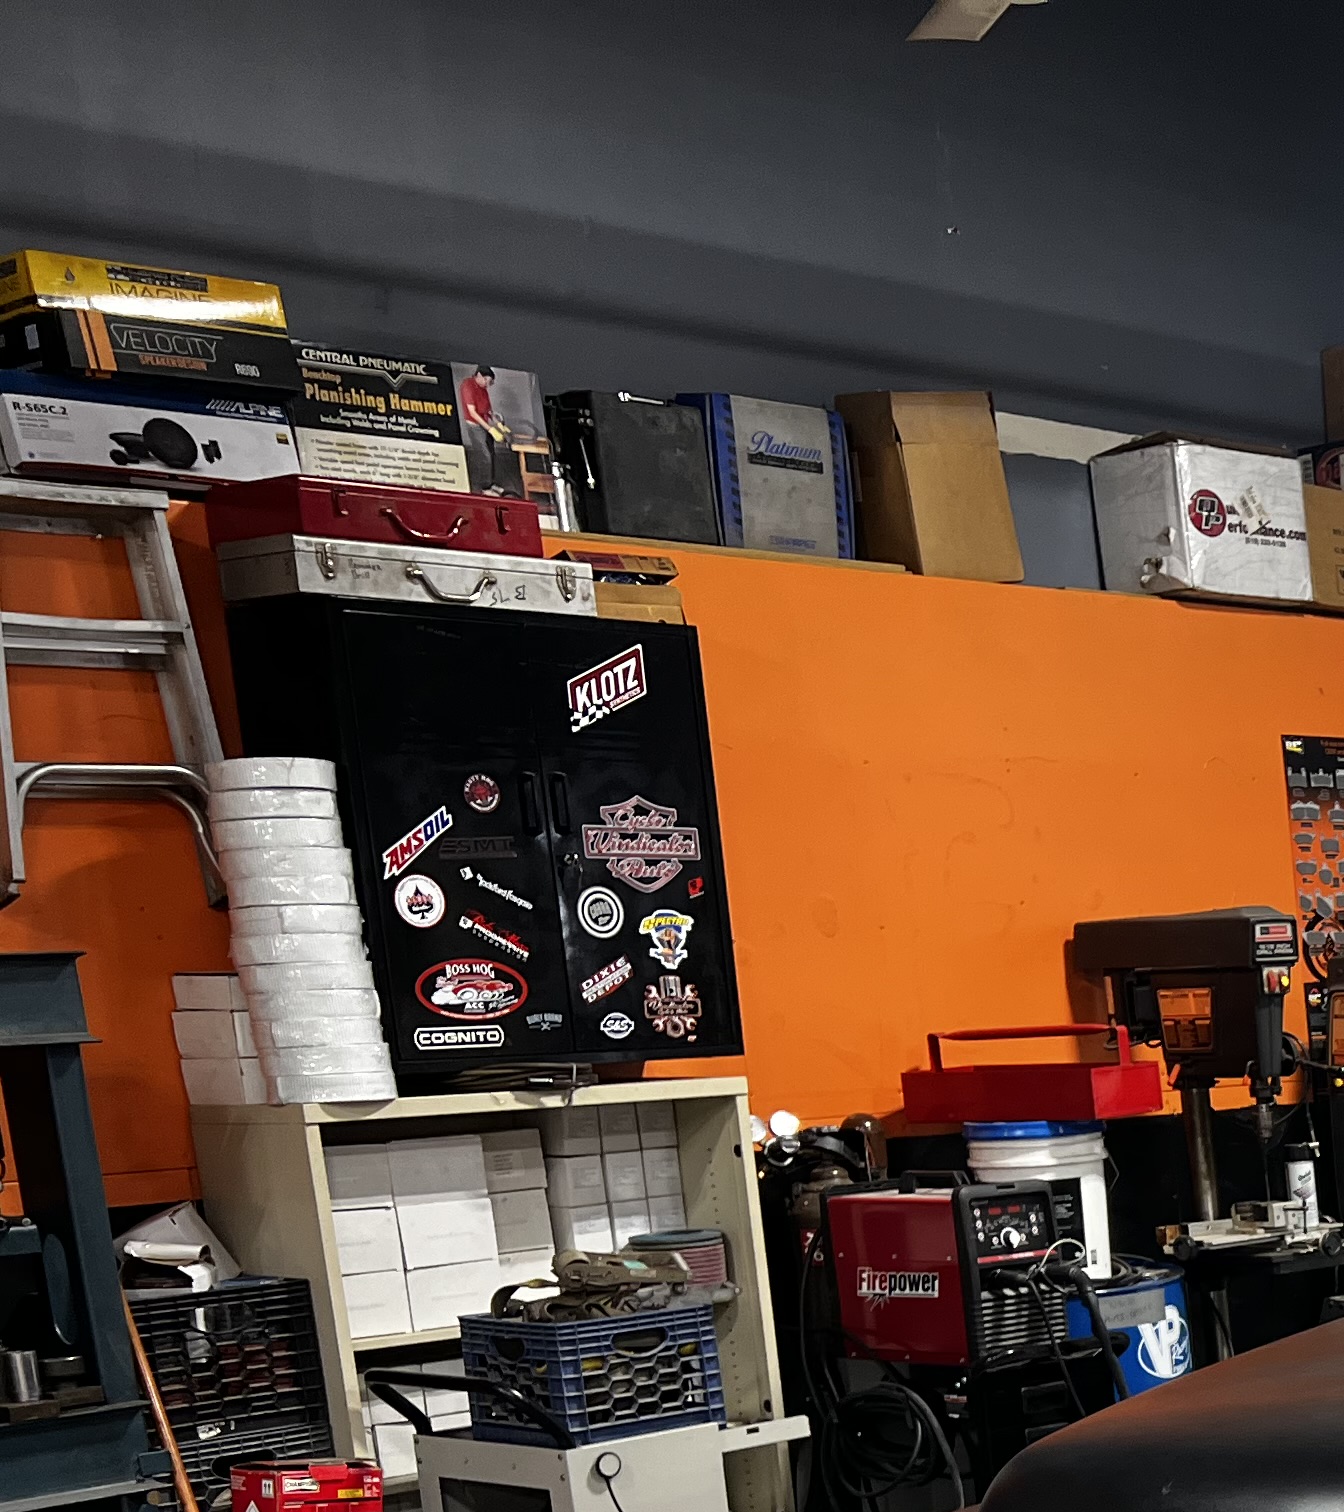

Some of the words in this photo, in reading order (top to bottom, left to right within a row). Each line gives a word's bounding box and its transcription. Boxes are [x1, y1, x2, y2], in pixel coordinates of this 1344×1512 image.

[114, 329, 217, 361] VELOCITY
[301, 348, 357, 367] CENTRAL
[359, 355, 428, 375] PNEUMATIC
[230, 401, 284, 418] ALPINE
[304, 383, 386, 413] Planishing
[389, 392, 453, 417] Hammer
[751, 430, 822, 460] Platinum
[575, 656, 639, 712] KLOTZ
[385, 810, 450, 873] AMSOIL
[586, 830, 695, 854] Vindicator
[445, 964, 471, 979] BOSS
[472, 963, 495, 979] HOG
[582, 955, 628, 990] DIXIE
[588, 972, 631, 1004] DEPOT
[418, 1030, 500, 1045] COGNITO
[605, 1019, 629, 1030] S&S
[858, 1268, 938, 1296] Firepower
[1138, 1305, 1180, 1377] VP
